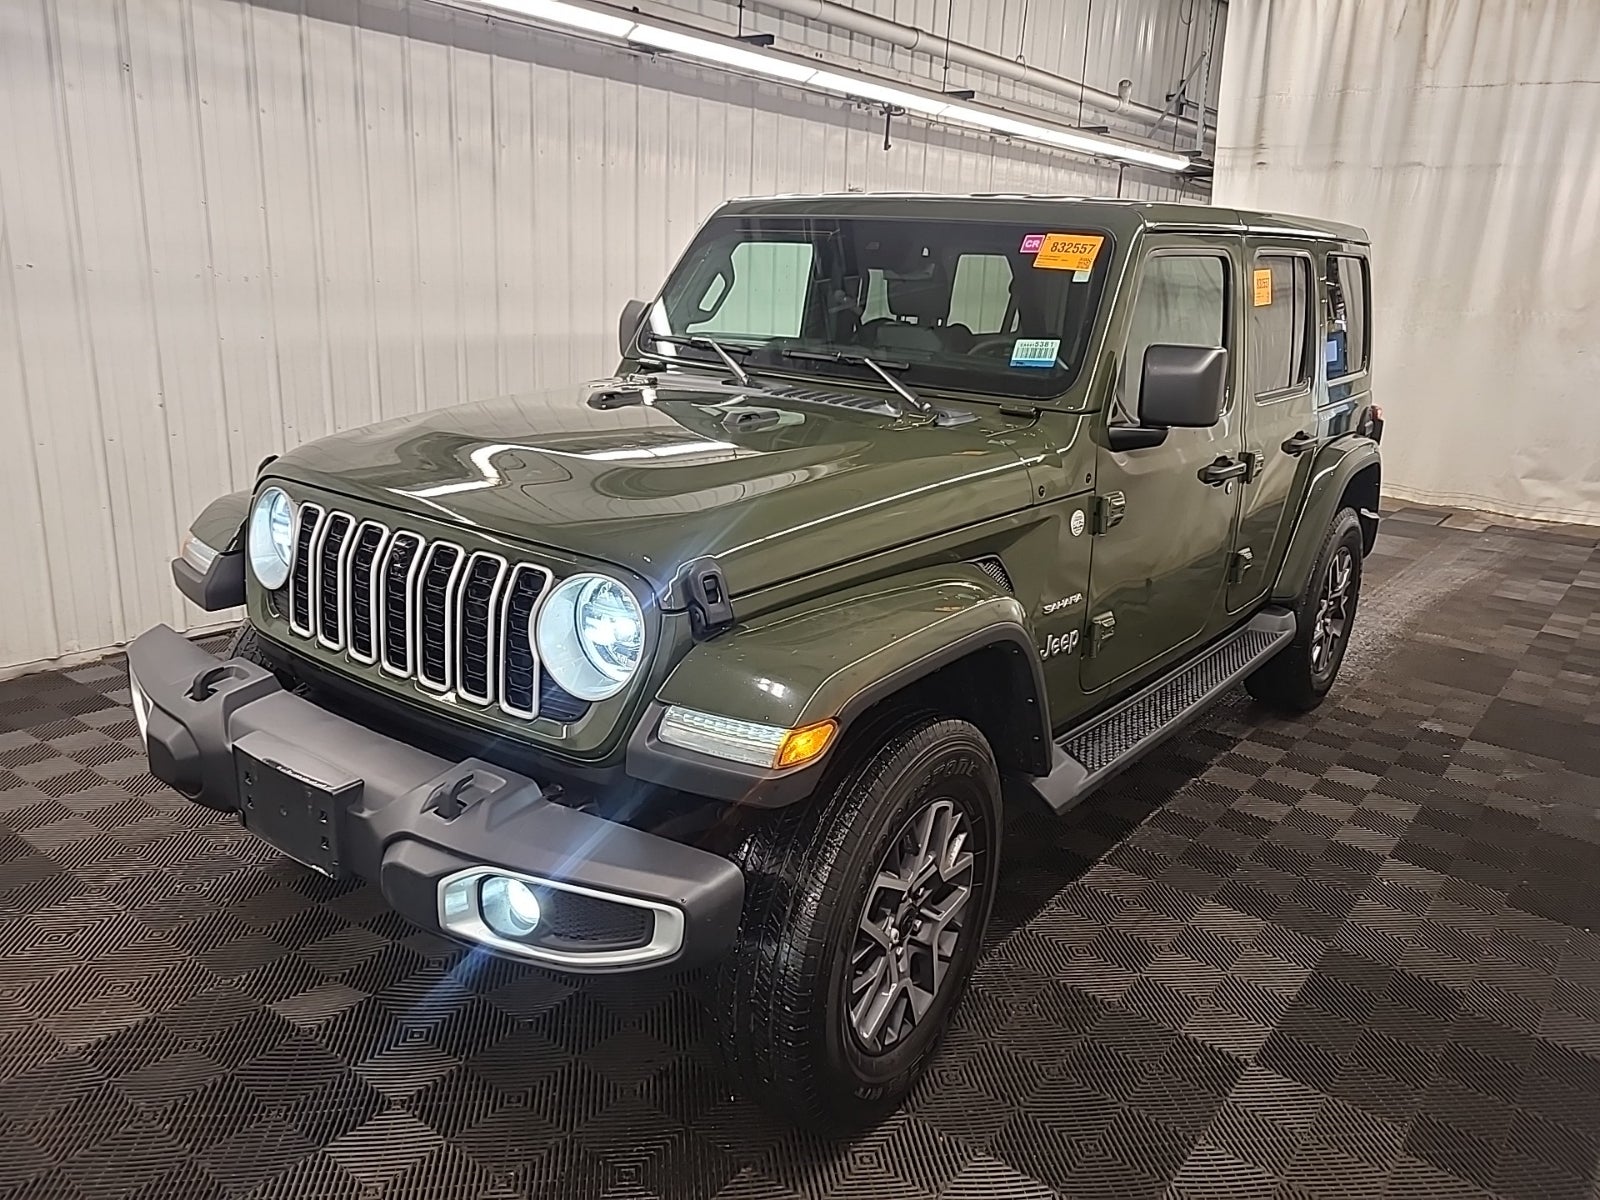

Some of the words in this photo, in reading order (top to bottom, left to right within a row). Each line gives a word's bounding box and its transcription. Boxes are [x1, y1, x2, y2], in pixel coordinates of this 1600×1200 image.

[1025, 239, 1040, 249] CR
[1050, 241, 1096, 255] 832557
[1043, 592, 1083, 614] SAHARA
[1039, 629, 1079, 660] Jeep
